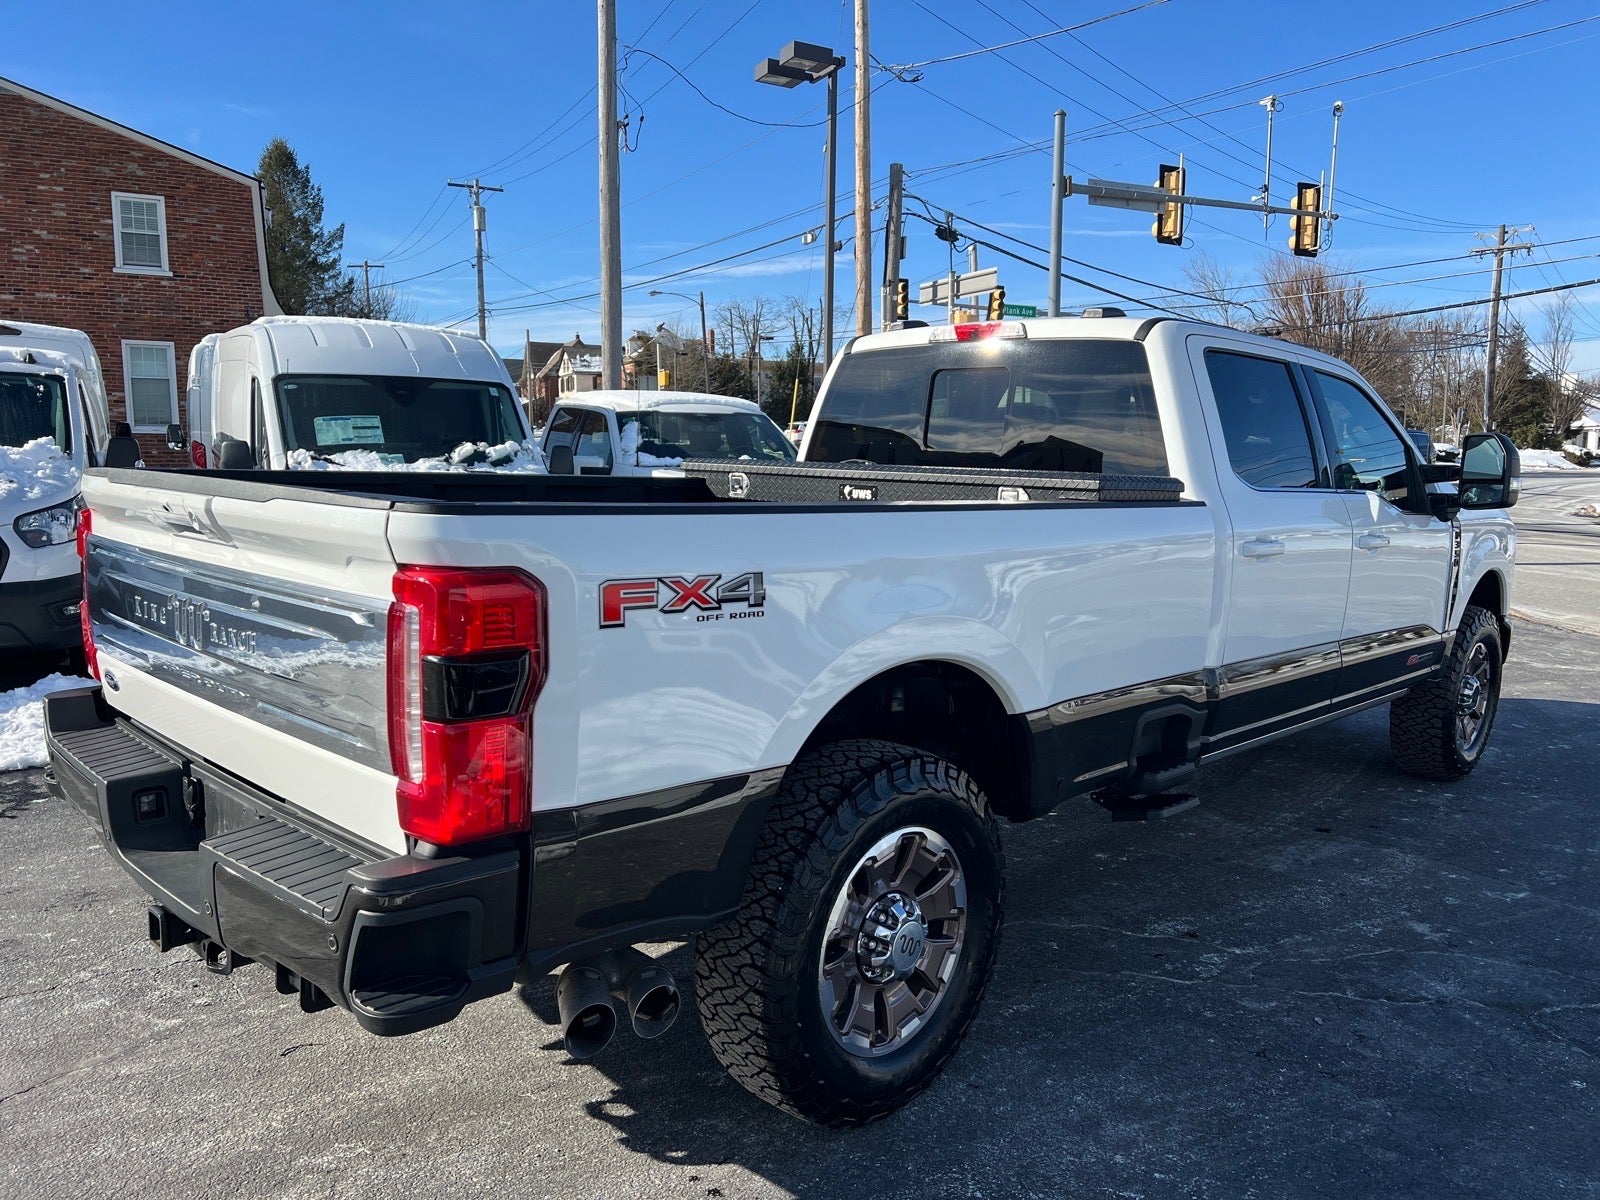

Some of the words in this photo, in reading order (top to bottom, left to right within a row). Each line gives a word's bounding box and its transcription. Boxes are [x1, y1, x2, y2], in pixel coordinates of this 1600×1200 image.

[1003, 307, 1020, 315] Plank
[1022, 308, 1033, 316] Ave
[852, 489, 872, 500] UWS
[599, 571, 766, 629] FX4
[696, 614, 725, 623] OFF
[729, 610, 765, 620] ROAD
[209, 622, 257, 654] RANCH
